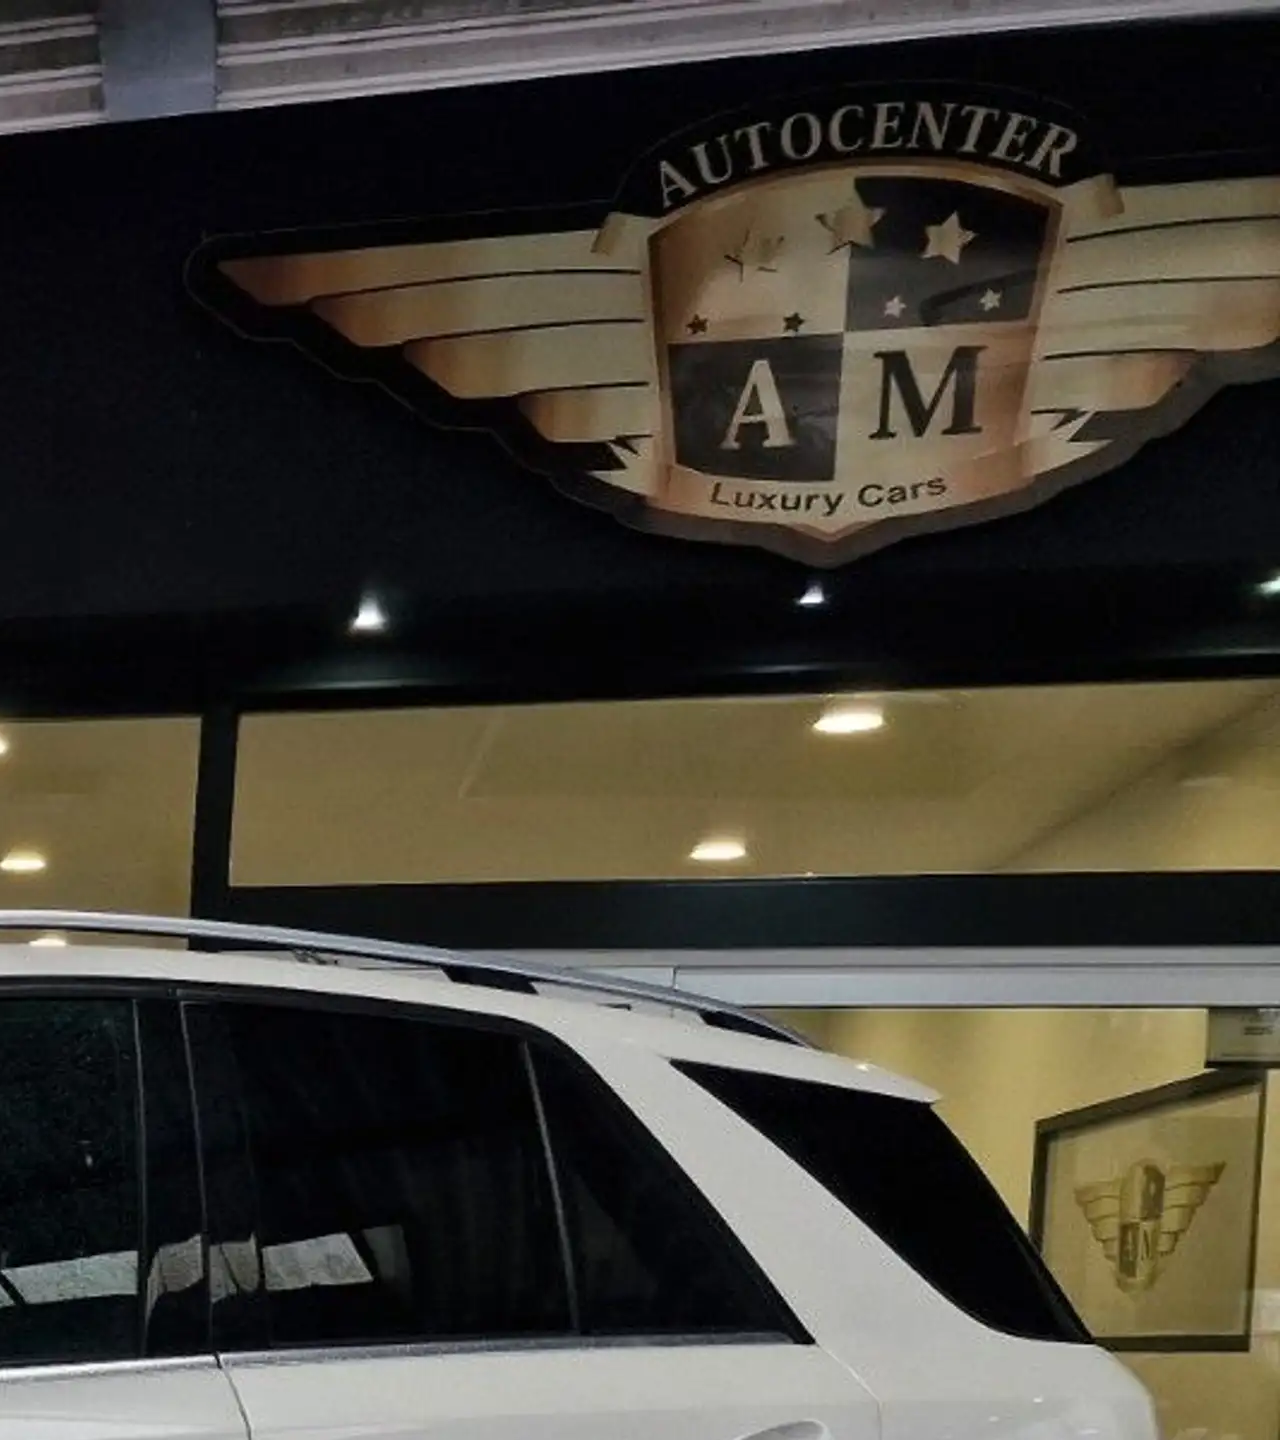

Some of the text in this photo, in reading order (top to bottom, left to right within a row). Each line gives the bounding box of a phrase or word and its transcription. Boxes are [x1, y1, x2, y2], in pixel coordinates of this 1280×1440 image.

[658, 102, 1078, 207] AUTOCENTER
[721, 346, 987, 449] A M
[710, 476, 947, 516] Luxury Cars
